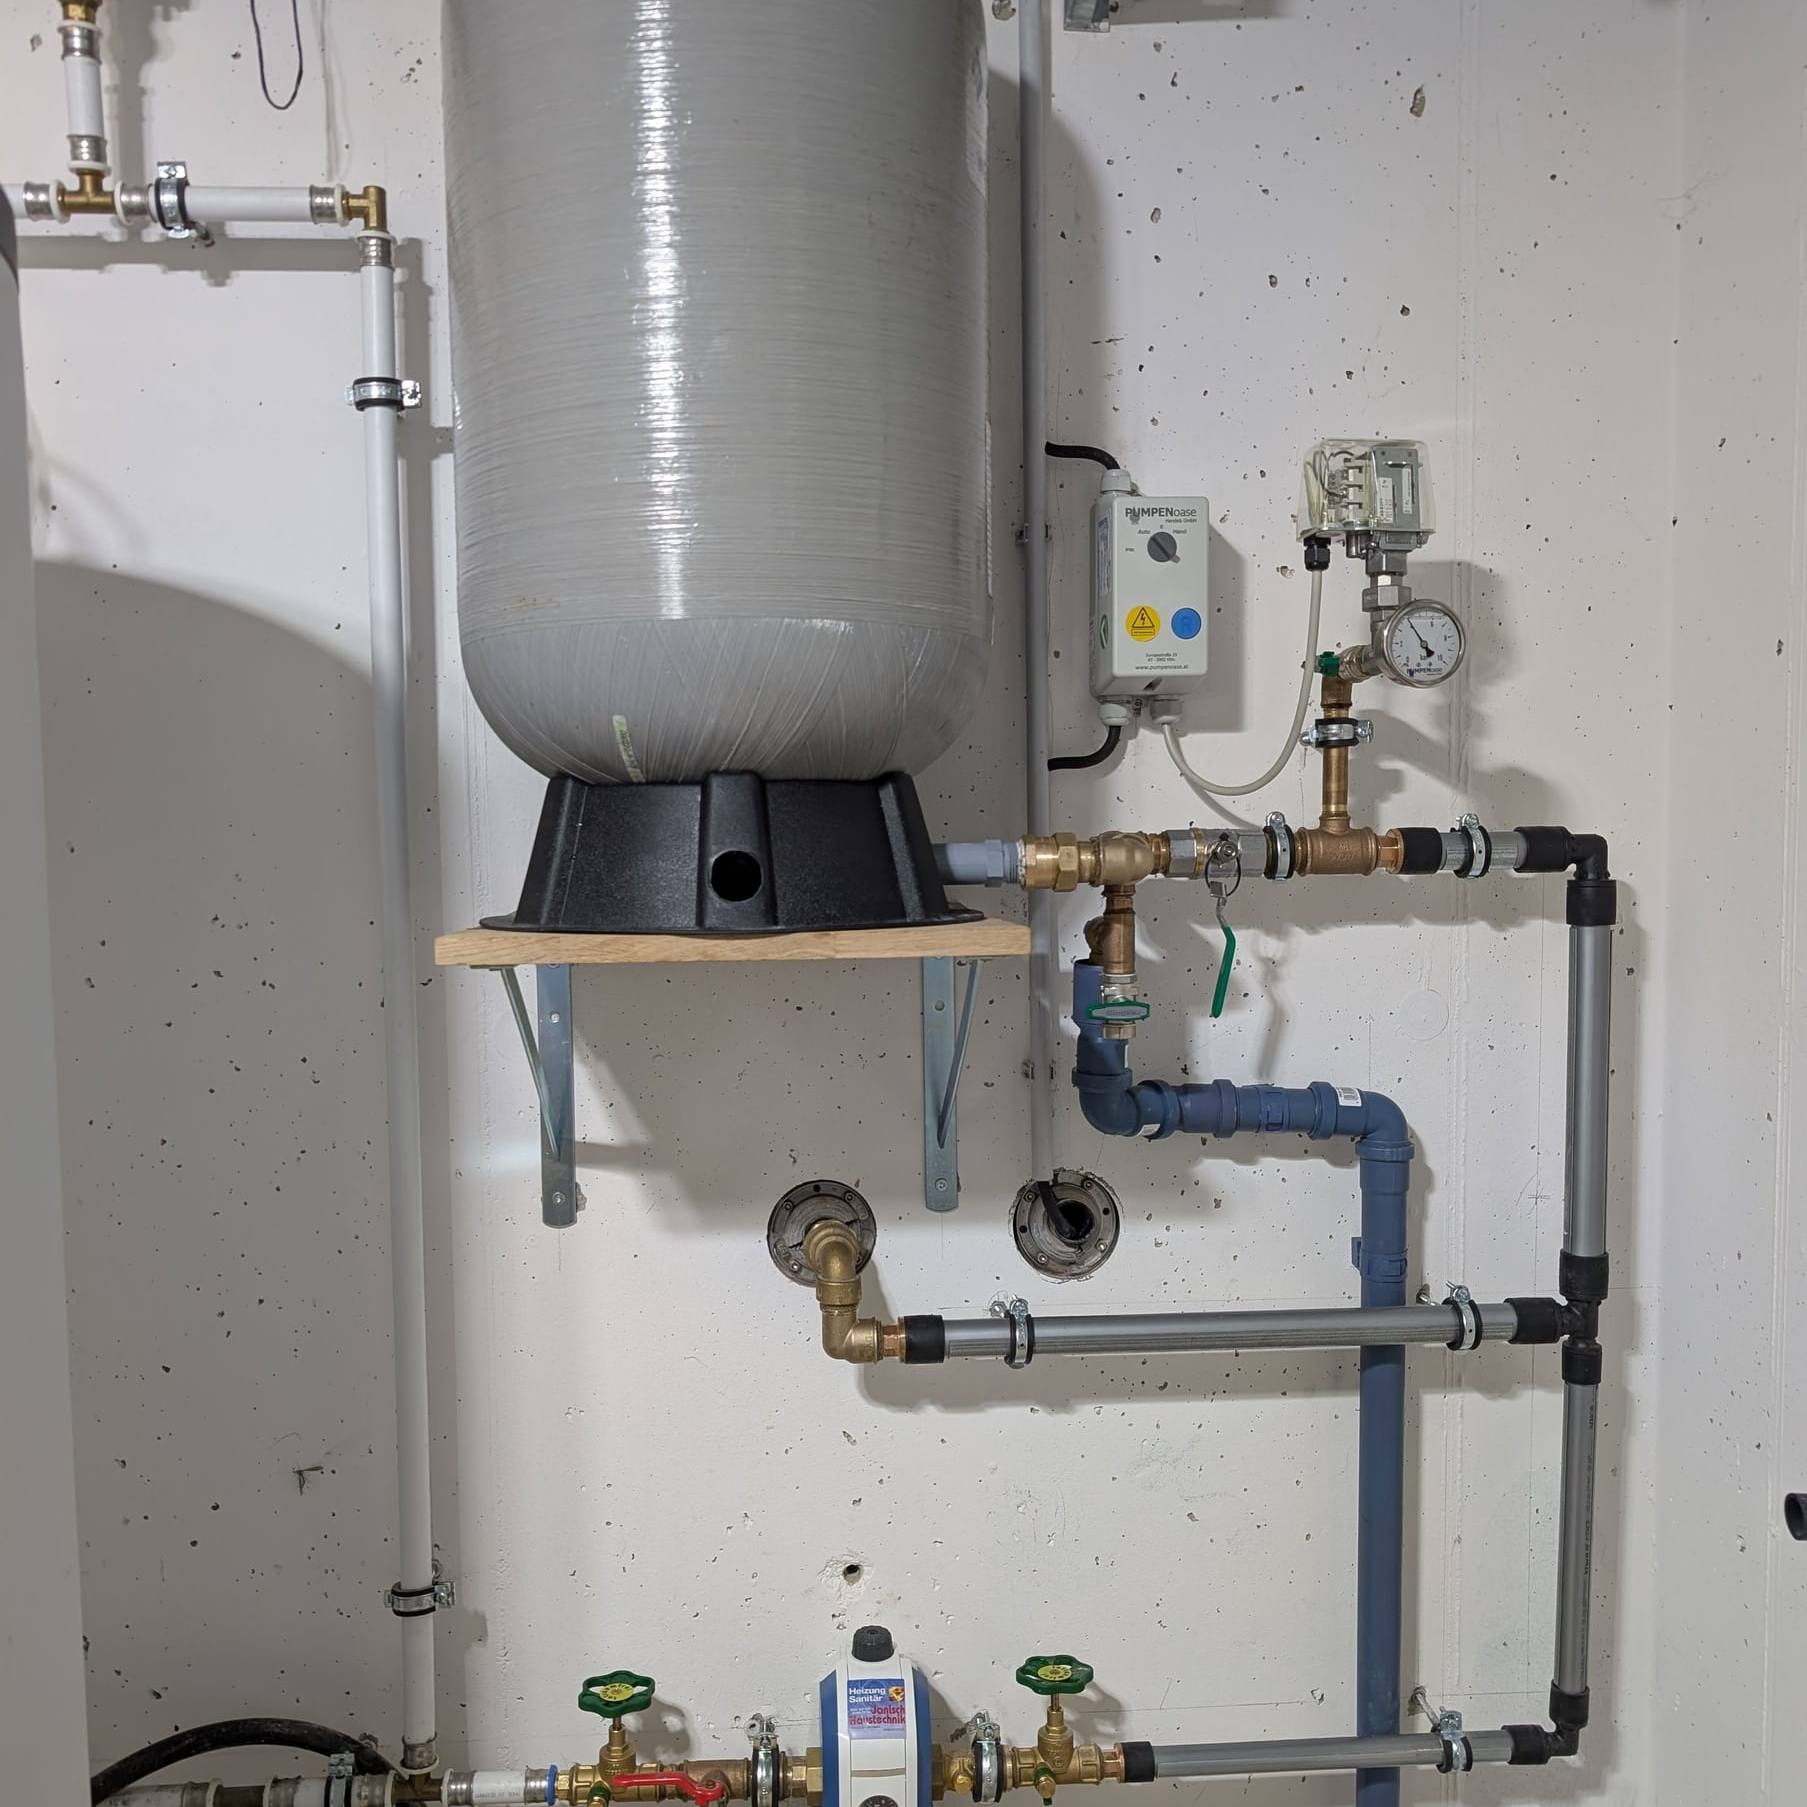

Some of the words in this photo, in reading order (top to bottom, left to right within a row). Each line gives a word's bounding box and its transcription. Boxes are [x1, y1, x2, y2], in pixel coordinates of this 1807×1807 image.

[1125, 507, 1197, 517] PUMPENoase
[849, 1687, 886, 1695] Heizung
[849, 1694, 883, 1703] Sanitär
[871, 1705, 905, 1714] Janisch
[849, 1714, 905, 1725] Haustechnik
